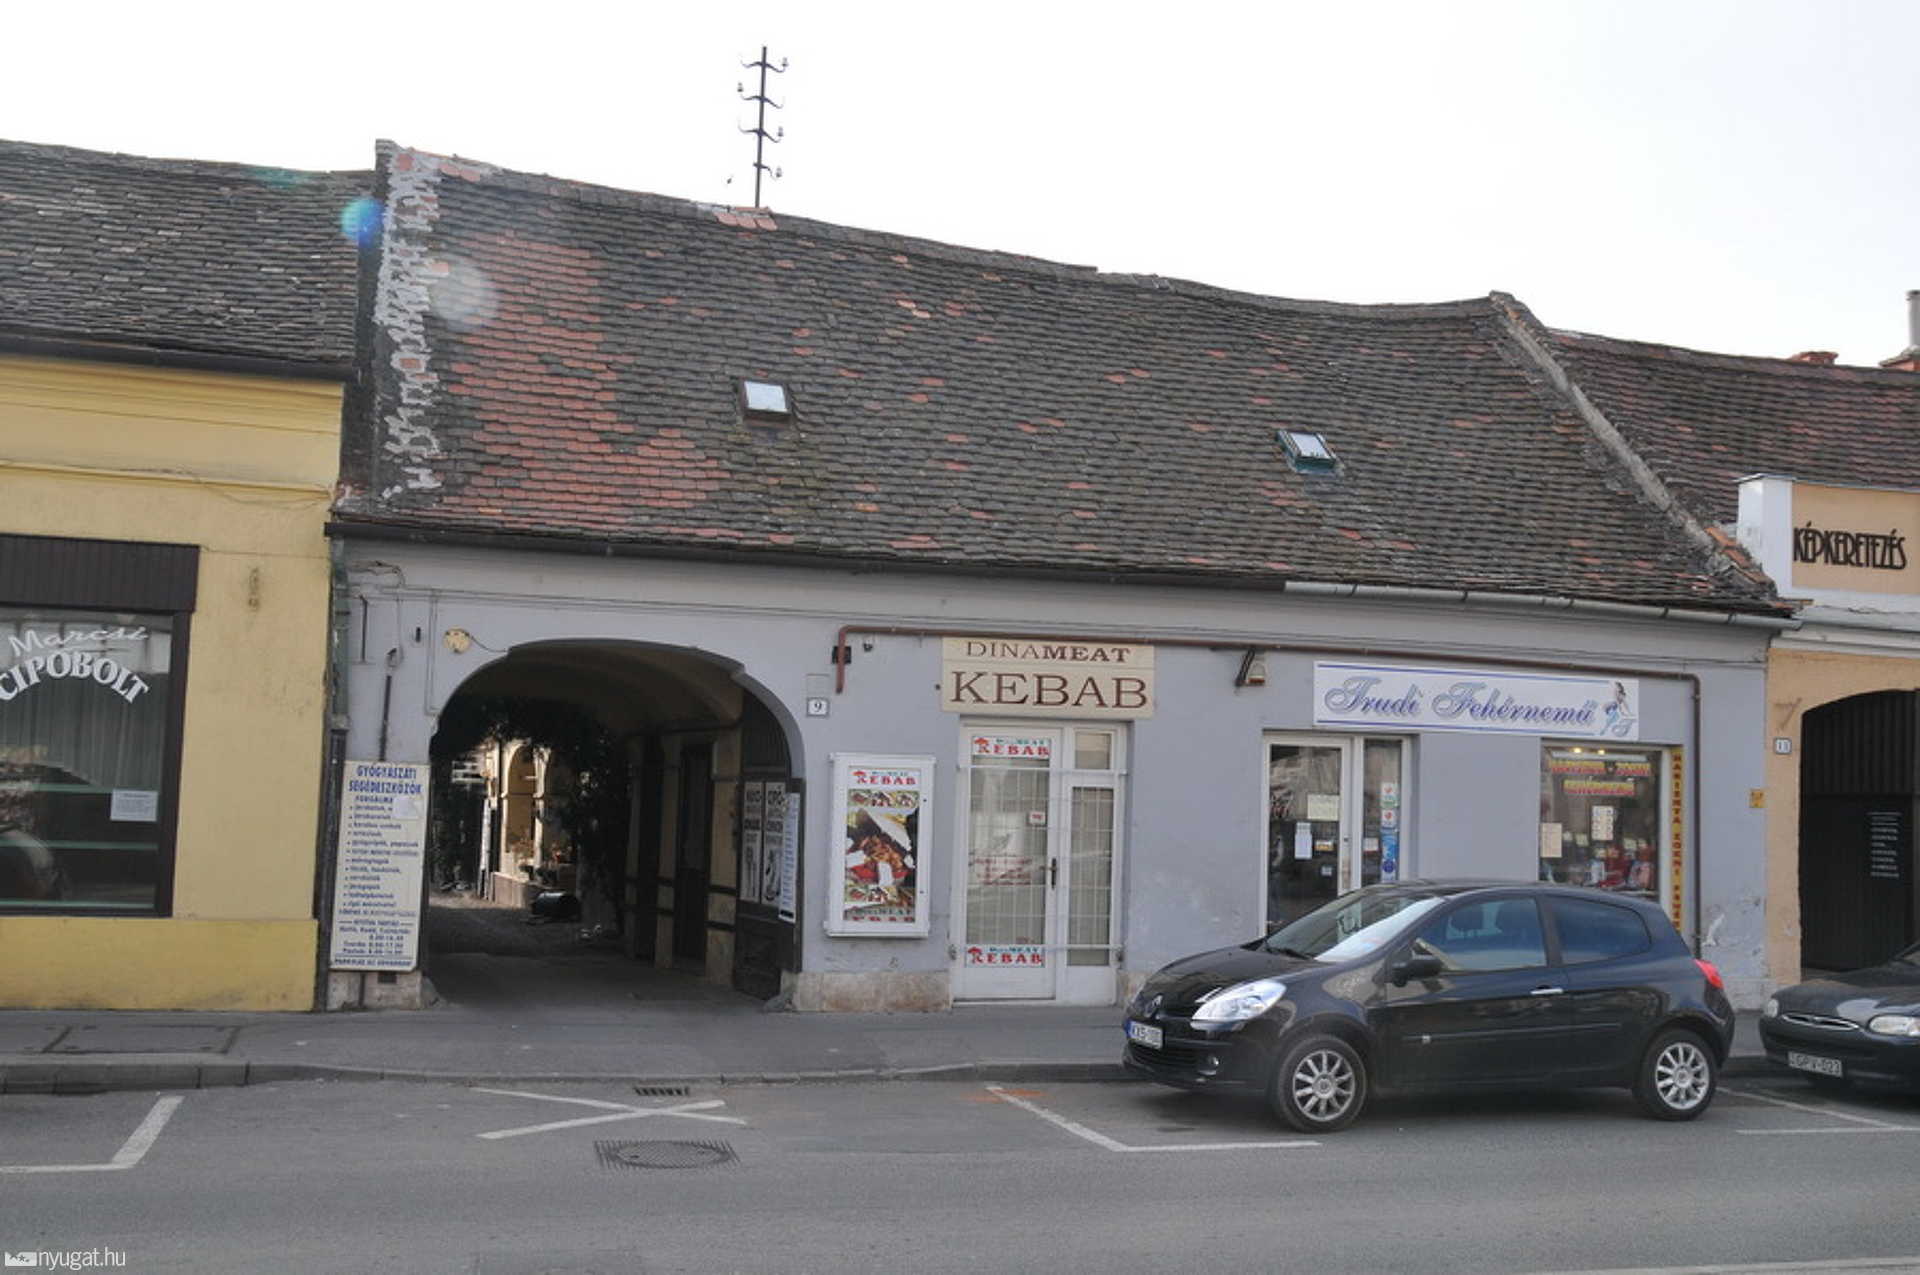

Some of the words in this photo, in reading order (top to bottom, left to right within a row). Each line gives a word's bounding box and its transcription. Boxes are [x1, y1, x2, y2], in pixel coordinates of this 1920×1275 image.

[1793, 520, 1907, 570] KÉPKERETEZÉS
[967, 641, 1130, 663] DINAMEAT
[951, 671, 1148, 709] KEBAB
[814, 701, 822, 713] 9
[977, 744, 1050, 756] KEBAB
[857, 776, 916, 785] KEBAB
[972, 952, 1042, 964] KEBAB
